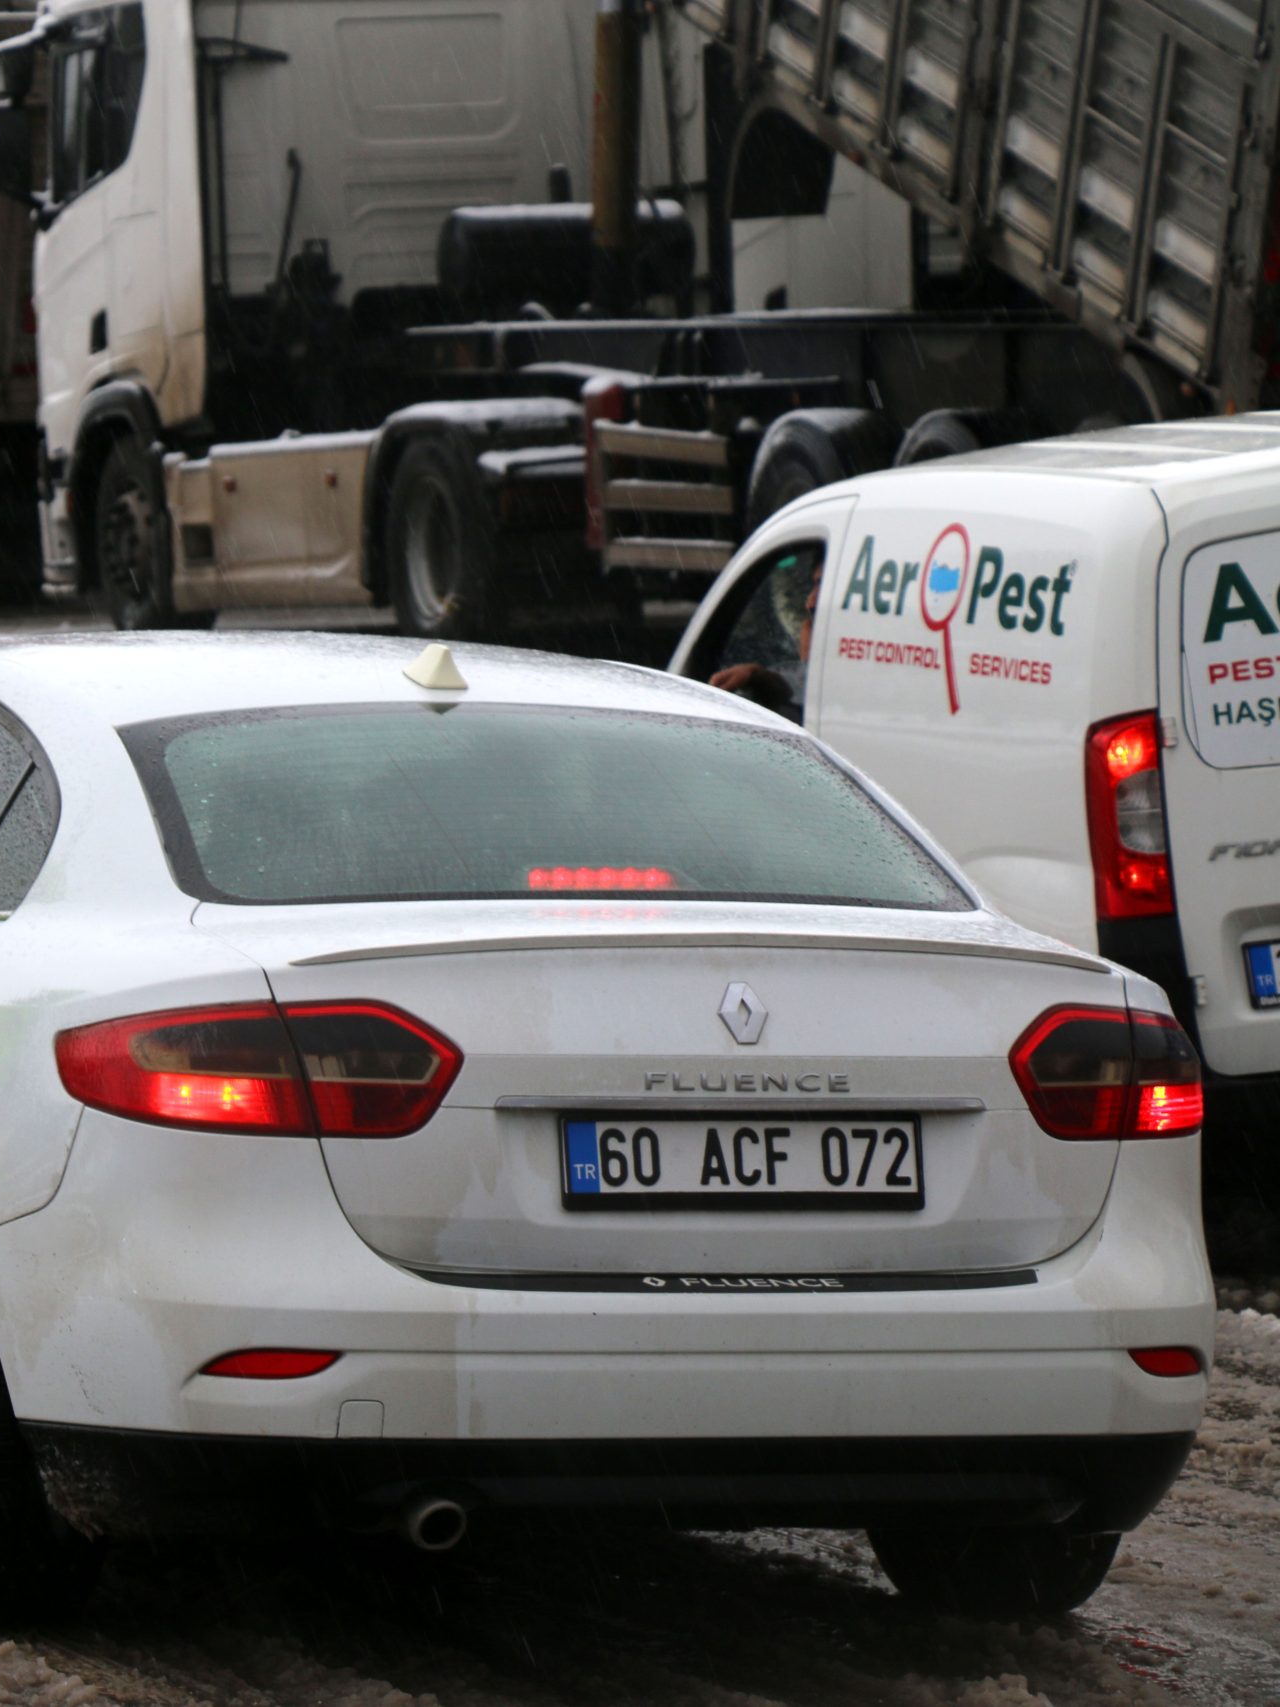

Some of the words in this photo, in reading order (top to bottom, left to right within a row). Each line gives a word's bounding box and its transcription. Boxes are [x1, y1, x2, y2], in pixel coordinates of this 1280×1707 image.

[1203, 562, 1280, 643] A
[839, 637, 874, 661] PEST
[875, 641, 941, 670] CONTROL
[968, 653, 1053, 685] SERVICES
[1208, 655, 1280, 685] PES
[1213, 696, 1280, 727] HAŞ
[1257, 974, 1275, 987] TR
[644, 1070, 851, 1093] FLUENCE
[573, 1163, 597, 1180] TR
[599, 1127, 661, 1187] 60
[700, 1127, 791, 1186] ACF
[820, 1127, 913, 1187] 072
[679, 1276, 845, 1288] FLUENCE
